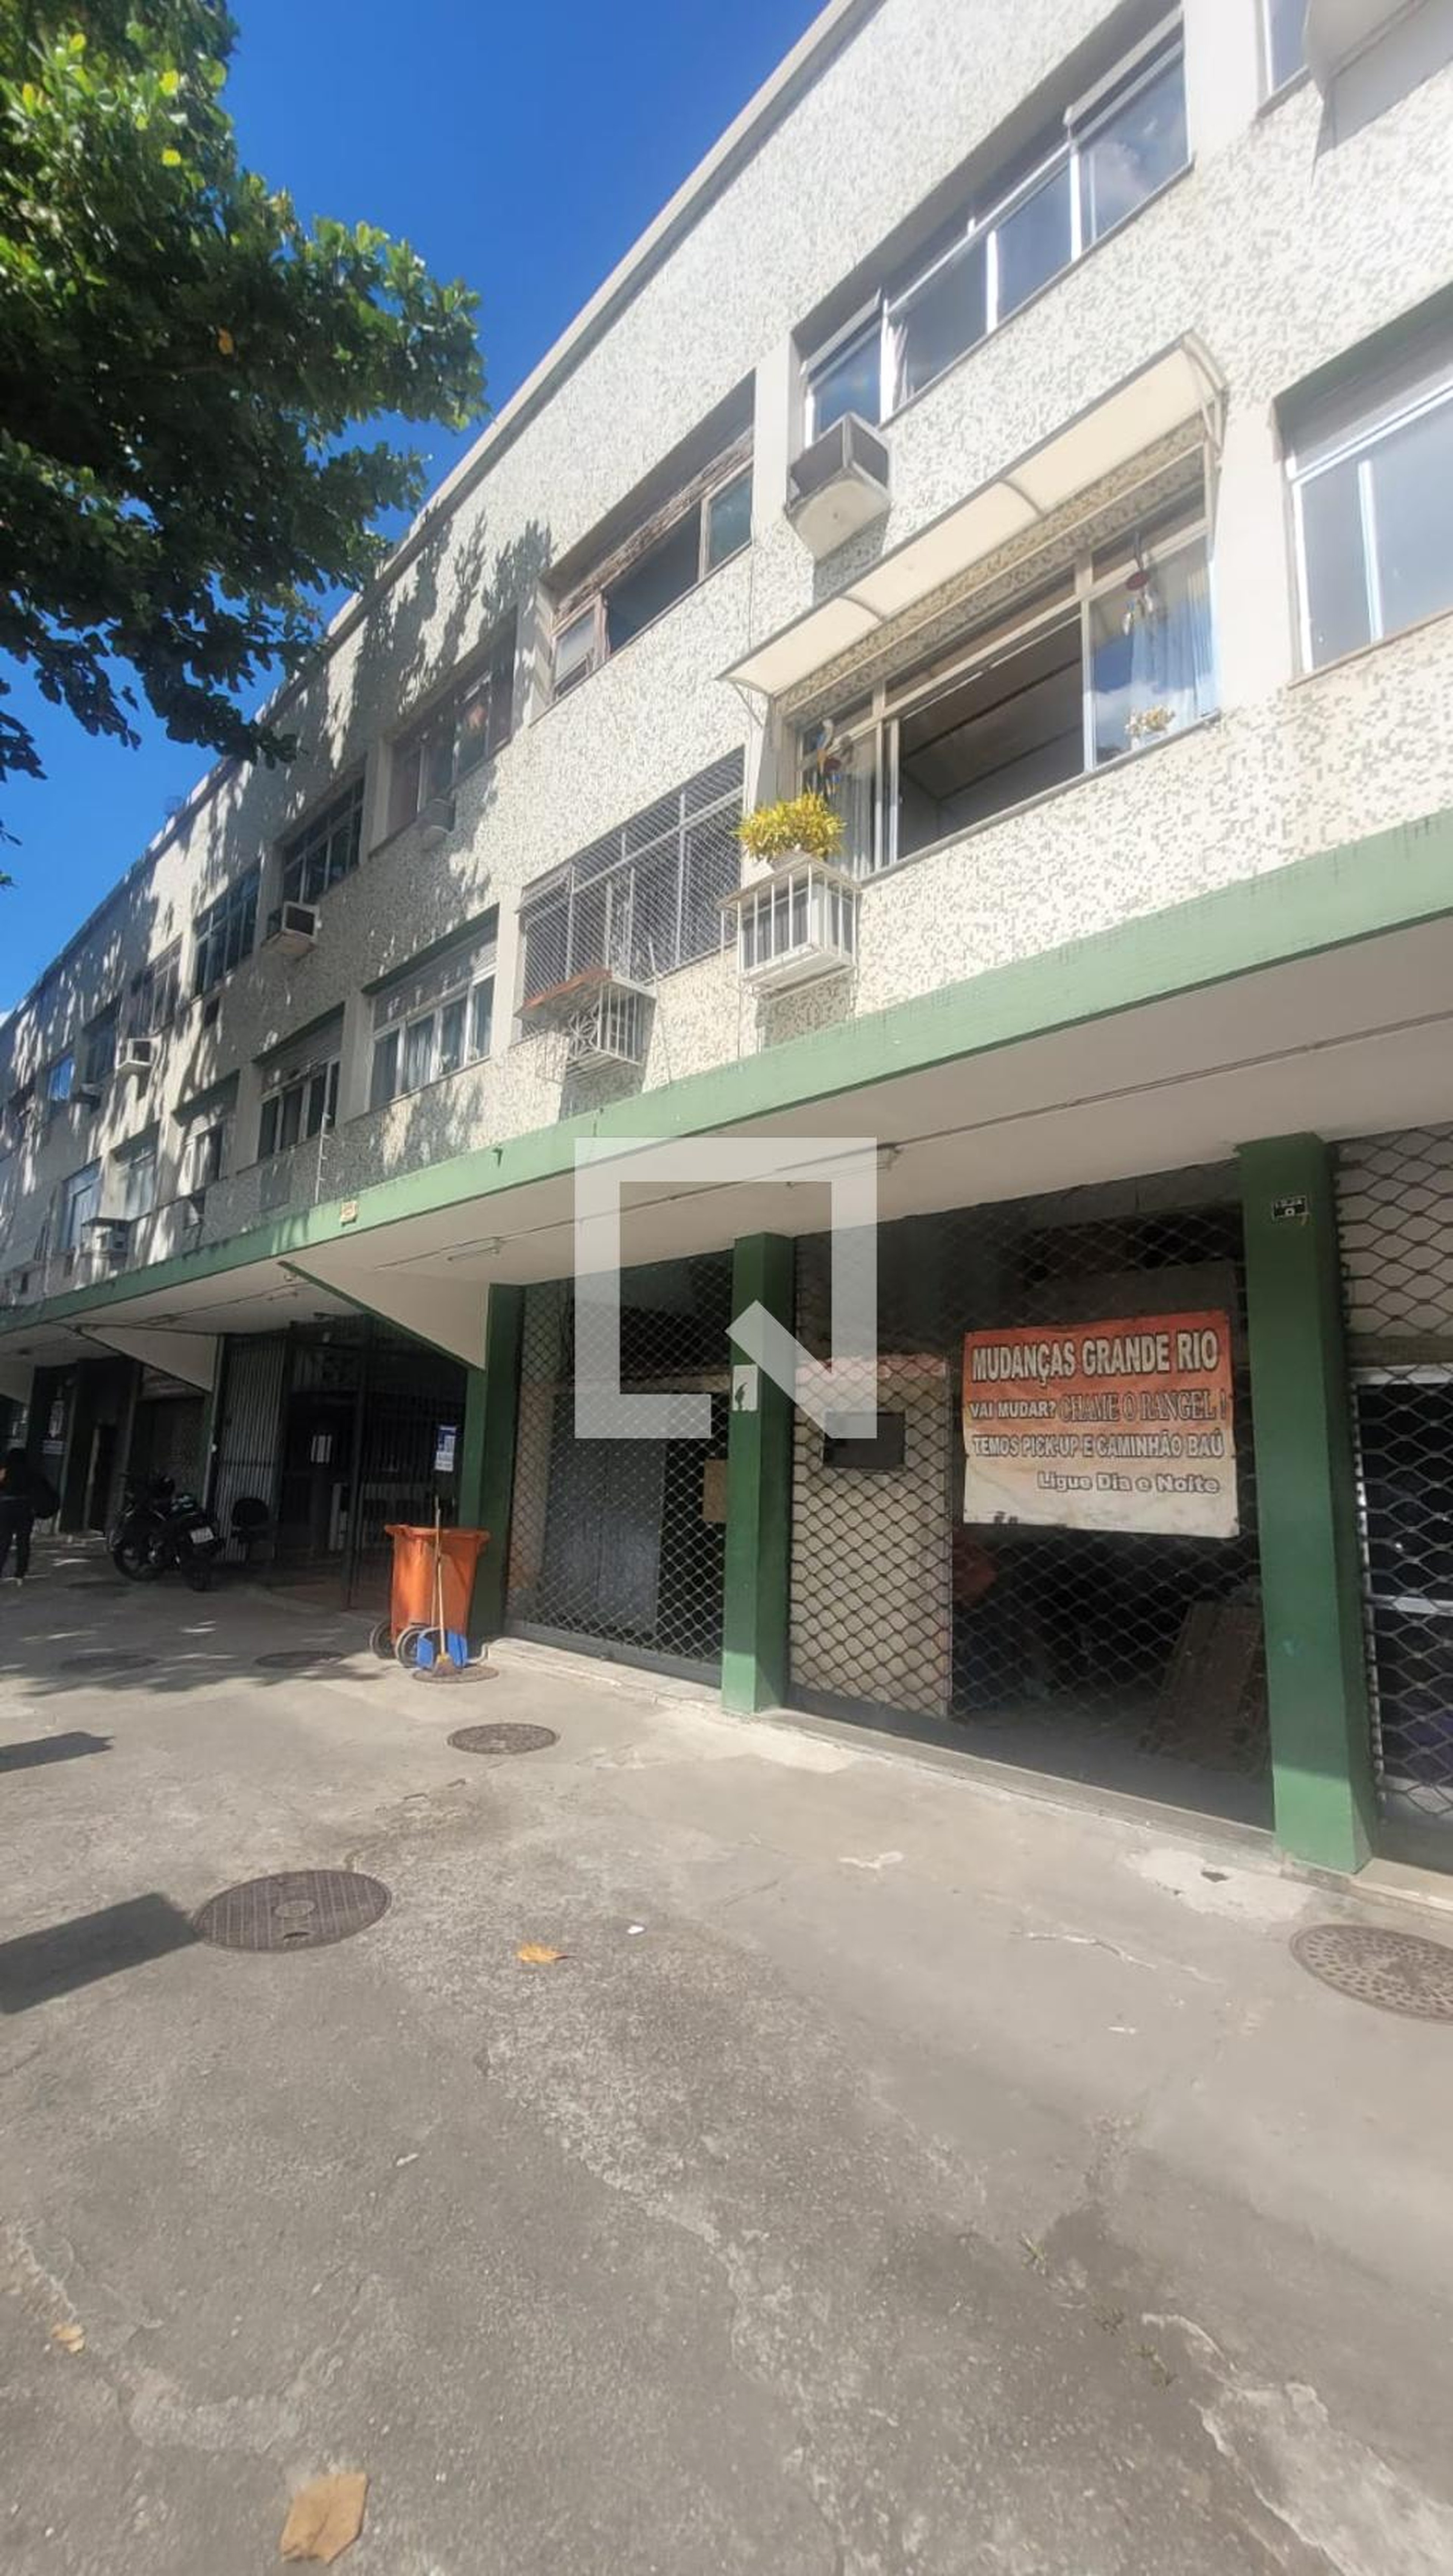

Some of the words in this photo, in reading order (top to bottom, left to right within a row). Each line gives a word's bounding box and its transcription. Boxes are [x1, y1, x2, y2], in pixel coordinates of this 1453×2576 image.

[972, 1340, 1076, 1387] MUDANÇAS
[1082, 1332, 1170, 1377] GRANDE
[1176, 1328, 1218, 1372] RIO
[969, 1401, 994, 1419] VAI
[998, 1400, 1056, 1419] MUDAR?
[1061, 1393, 1119, 1422] CHAME
[972, 1435, 1020, 1457] TEMOS
[1022, 1434, 1079, 1457] PICK-UP
[1082, 1434, 1094, 1457] E
[1097, 1430, 1182, 1457] CAMINHÃO
[1187, 1428, 1224, 1457] BAÚ
[1038, 1471, 1092, 1492] Ligue
[1096, 1472, 1133, 1491] Dia
[1136, 1477, 1152, 1492] e
[1156, 1474, 1221, 1493] Noite
